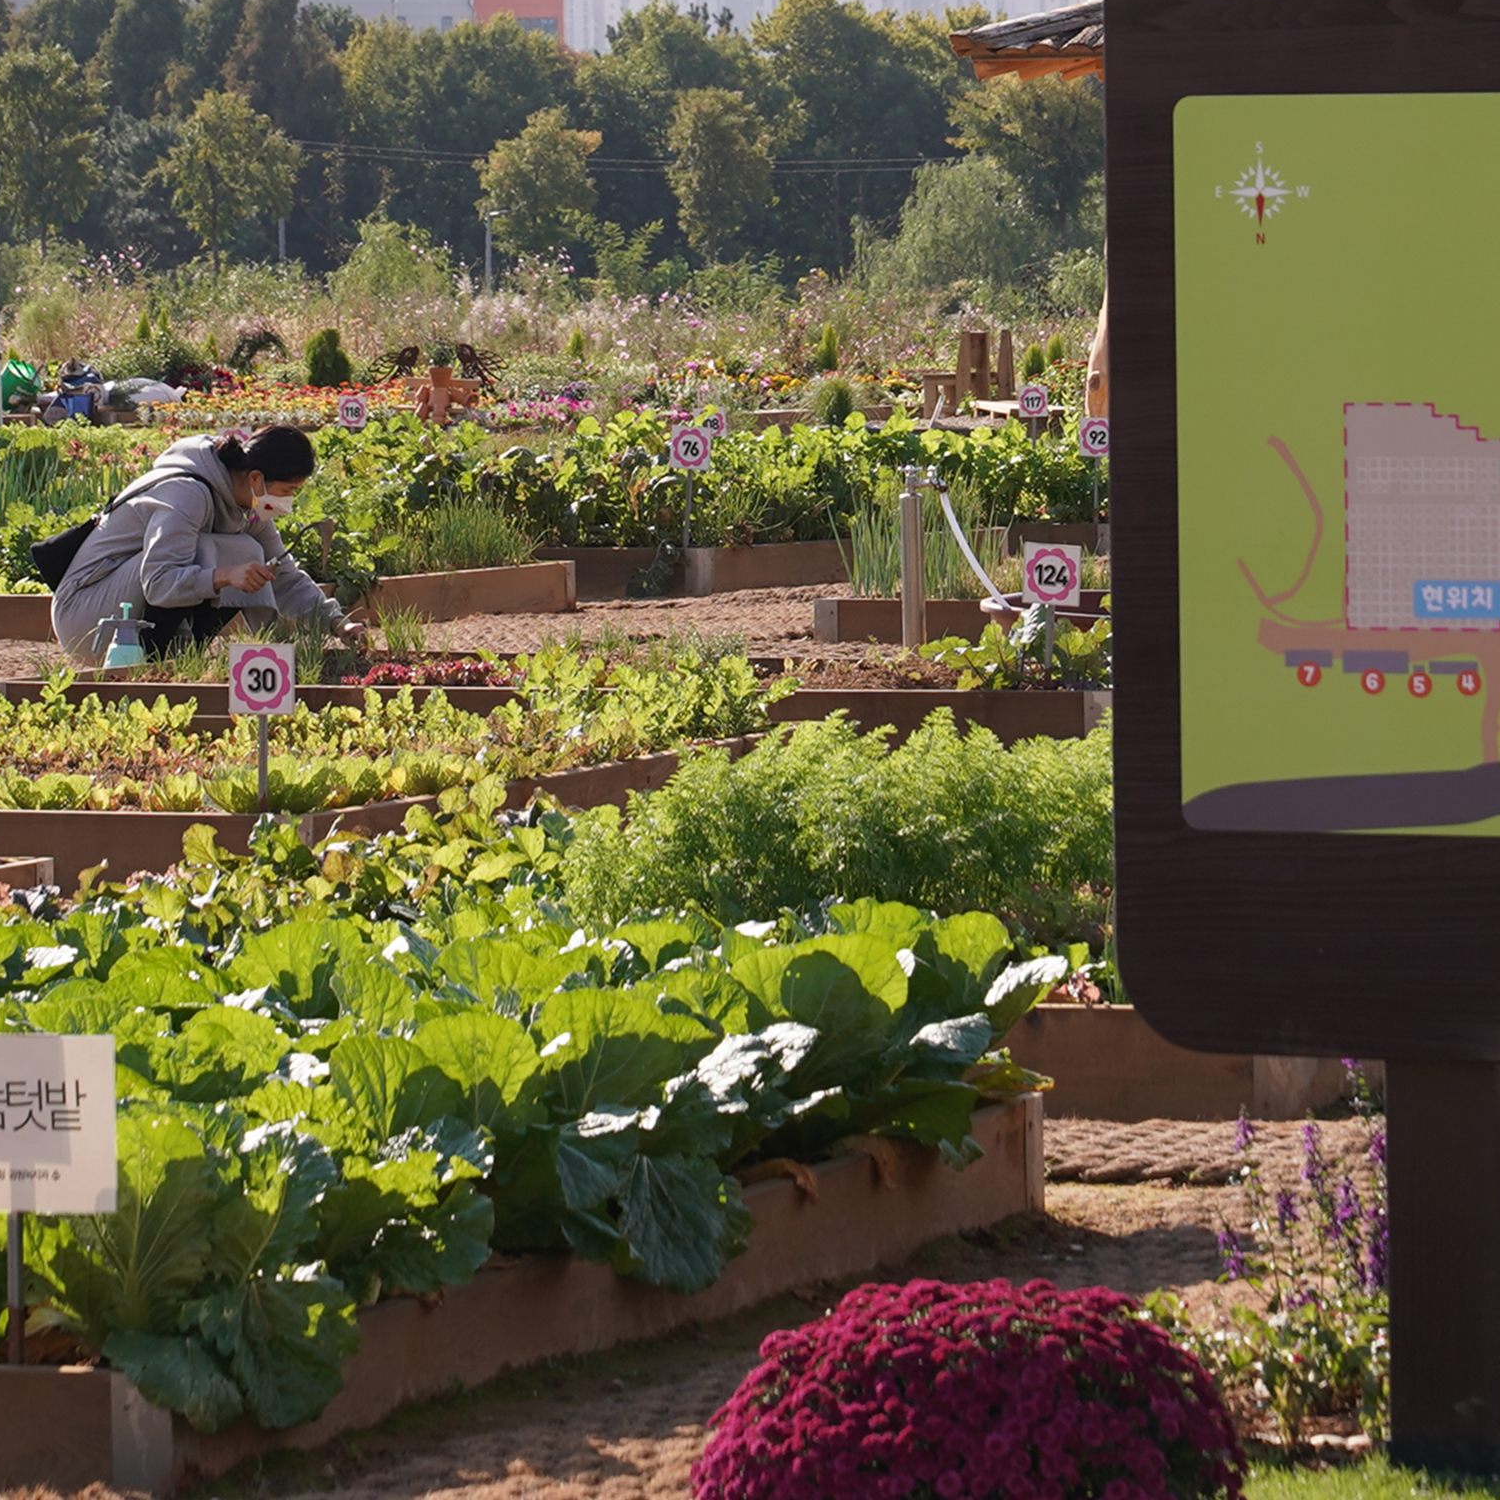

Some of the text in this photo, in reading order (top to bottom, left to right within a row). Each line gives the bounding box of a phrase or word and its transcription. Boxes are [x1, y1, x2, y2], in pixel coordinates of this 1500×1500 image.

[1255, 140, 1264, 155] S
[1214, 185, 1223, 199] E
[1295, 185, 1310, 198] W
[1254, 232, 1267, 247] N
[1025, 396, 1041, 408] 117
[344, 406, 361, 418] 118
[1089, 430, 1107, 446] 92
[682, 440, 700, 457] 76
[1035, 564, 1068, 586] 124
[1422, 585, 1492, 611] 현위치
[248, 668, 275, 692] 30
[1303, 666, 1315, 683] 7
[1365, 673, 1379, 690] 6
[1461, 674, 1475, 691] 4
[1413, 676, 1426, 694] 5
